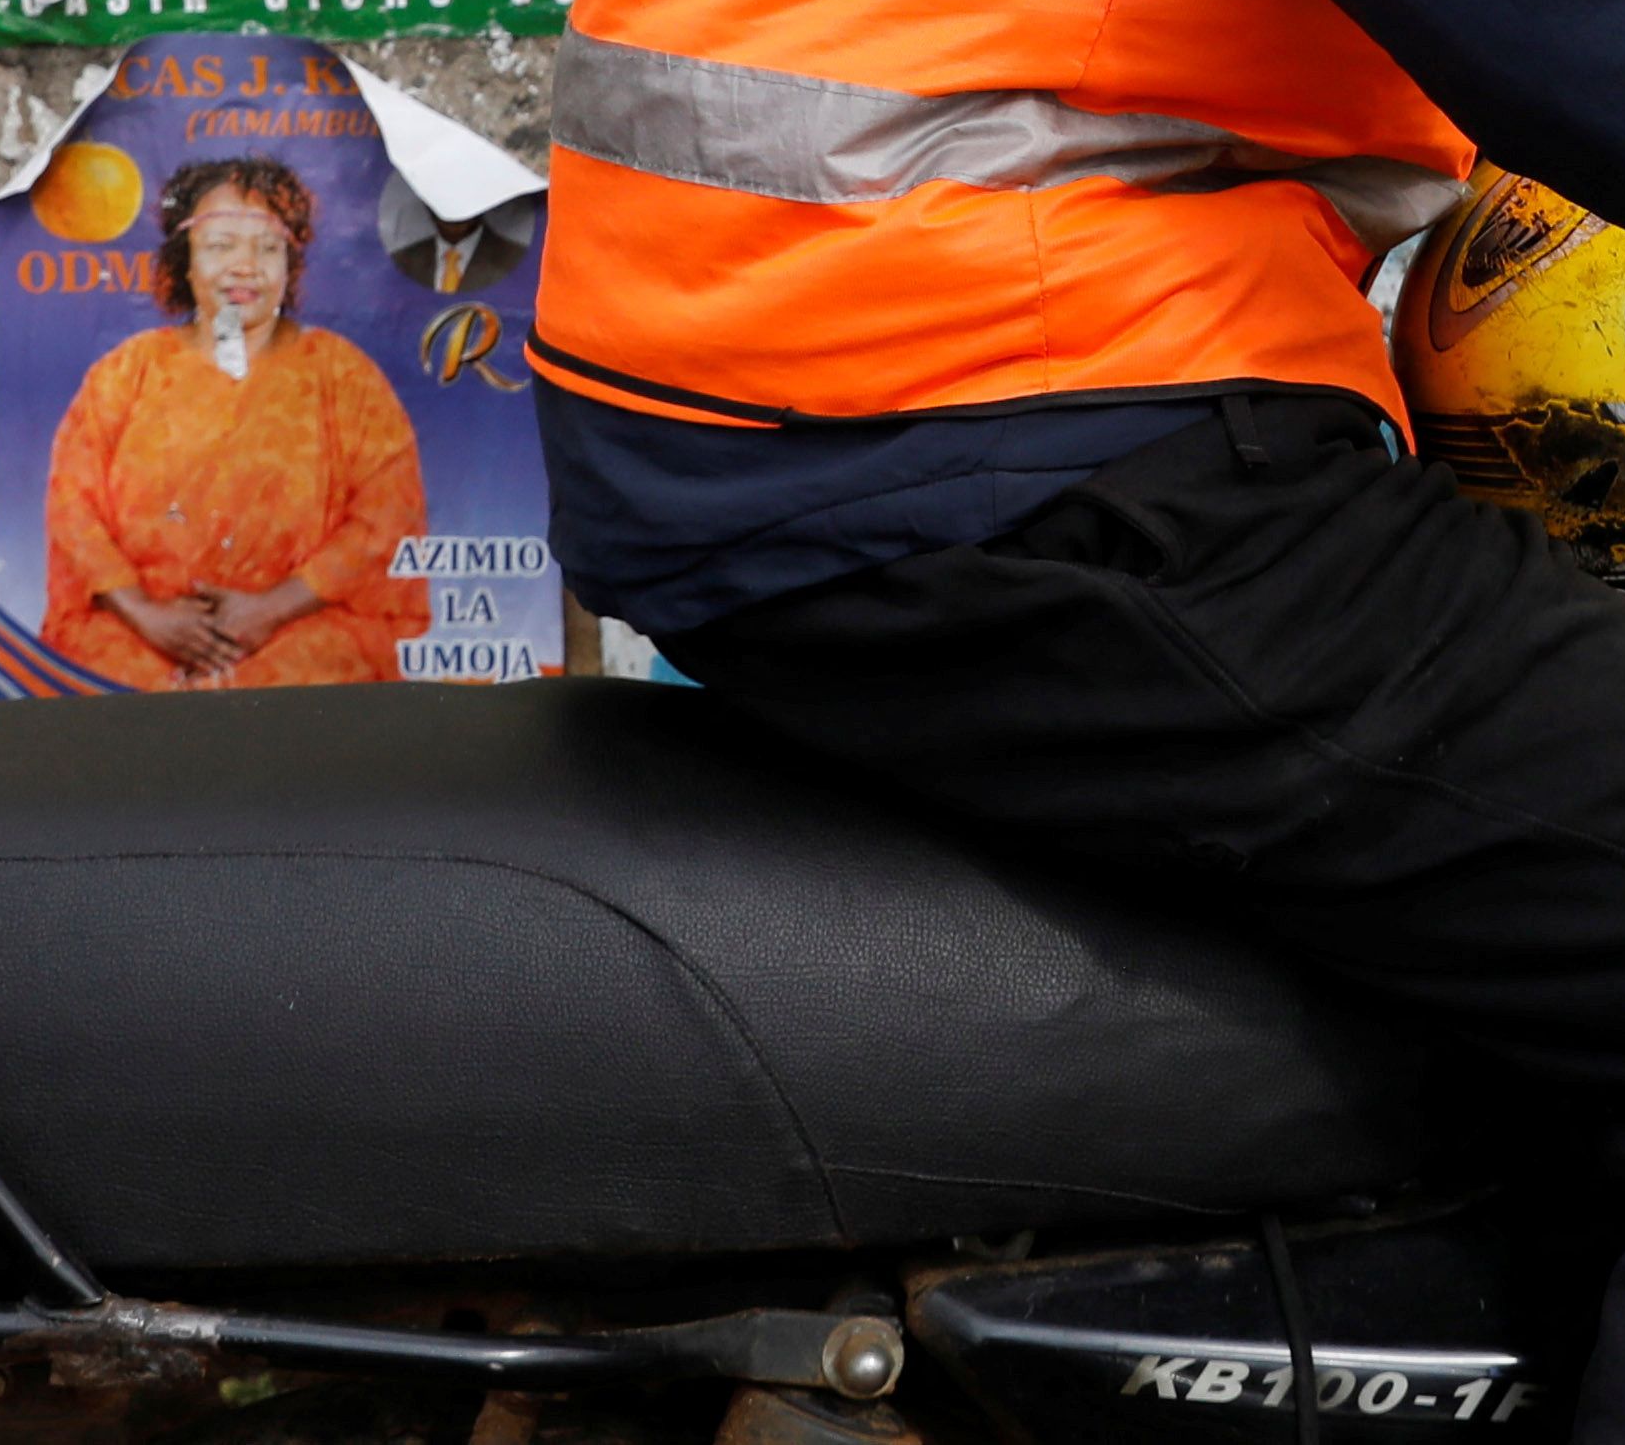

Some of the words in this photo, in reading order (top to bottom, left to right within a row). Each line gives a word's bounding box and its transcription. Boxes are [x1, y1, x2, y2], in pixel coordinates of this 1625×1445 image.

[108, 55, 224, 100] CAS
[239, 56, 285, 97] J.
[17, 251, 153, 296] ODM
[390, 537, 548, 579] AZIMIO
[443, 588, 496, 626] LA
[399, 639, 537, 683] UMOJA
